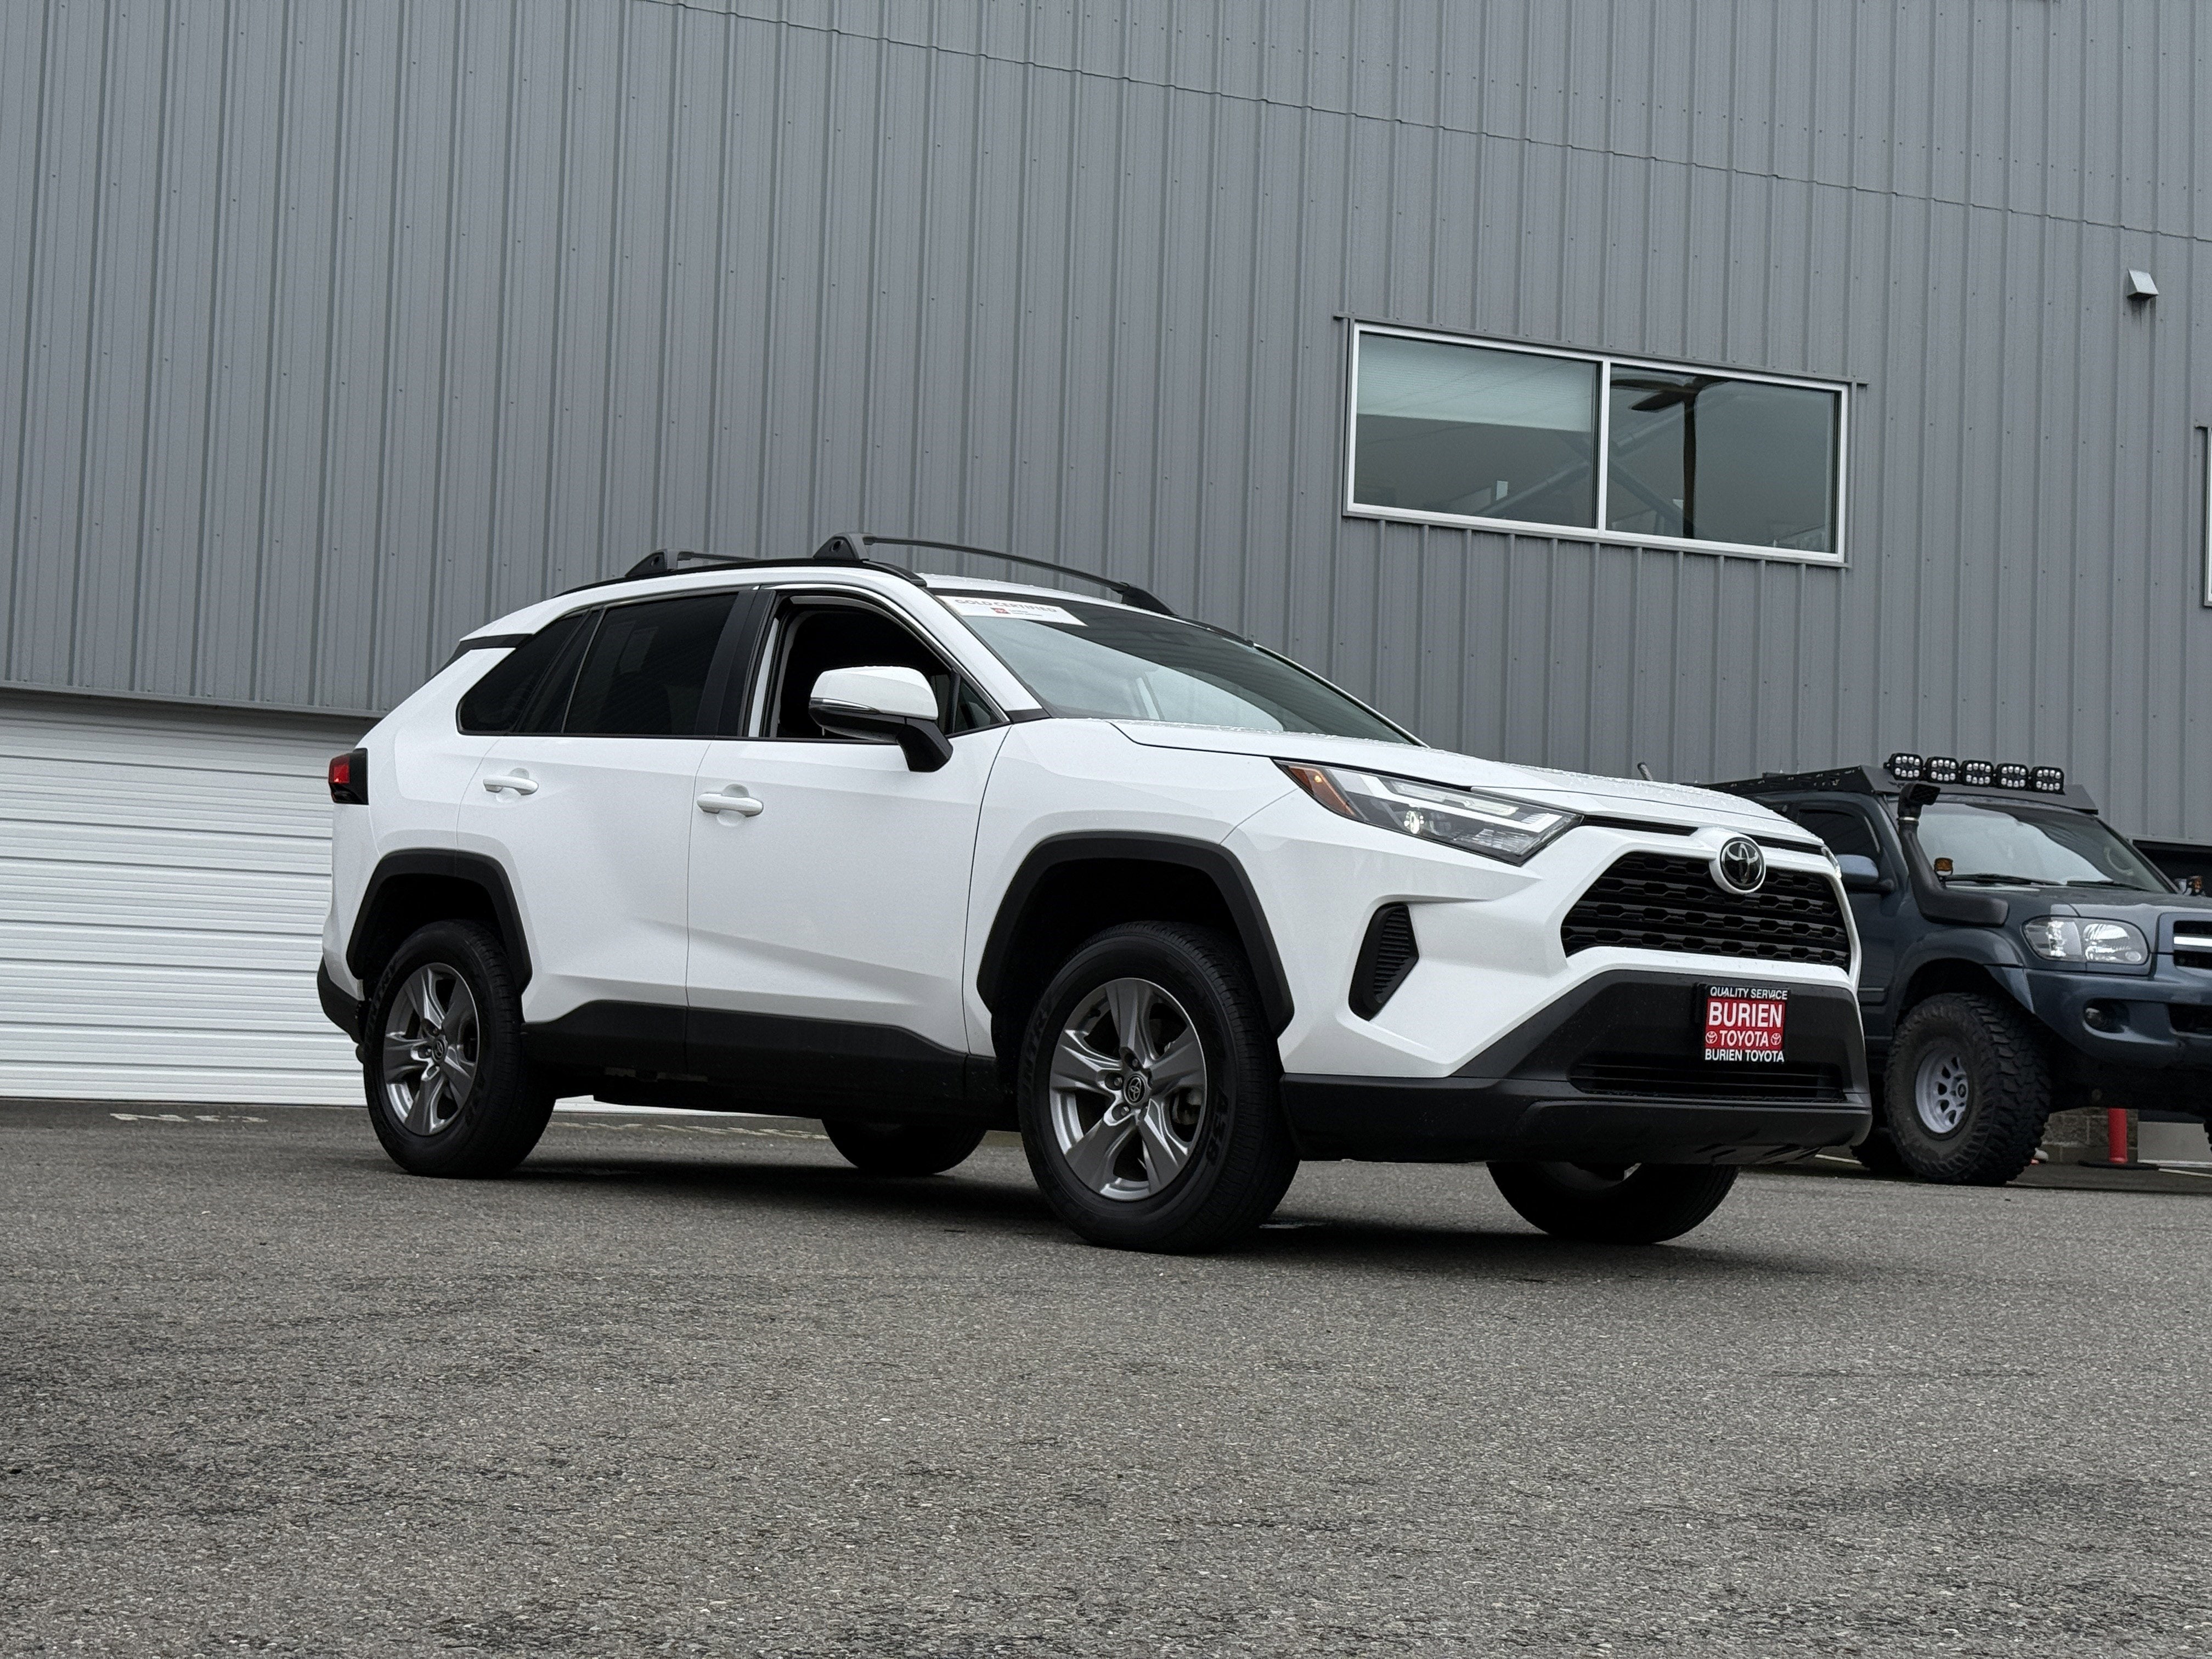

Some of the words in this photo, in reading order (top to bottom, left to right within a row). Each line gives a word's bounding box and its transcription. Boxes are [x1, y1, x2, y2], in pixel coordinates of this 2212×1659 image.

[994, 602, 1057, 612] CERTIFIED
[1710, 986, 1748, 998] QUALITY
[1750, 989, 1788, 1000] SERVICE
[1708, 1002, 1782, 1028] BURIEN
[1719, 1030, 1769, 1047] TOYOTA
[1705, 1048, 1742, 1061] BURIEN
[1745, 1049, 1785, 1062] TOYOTA
